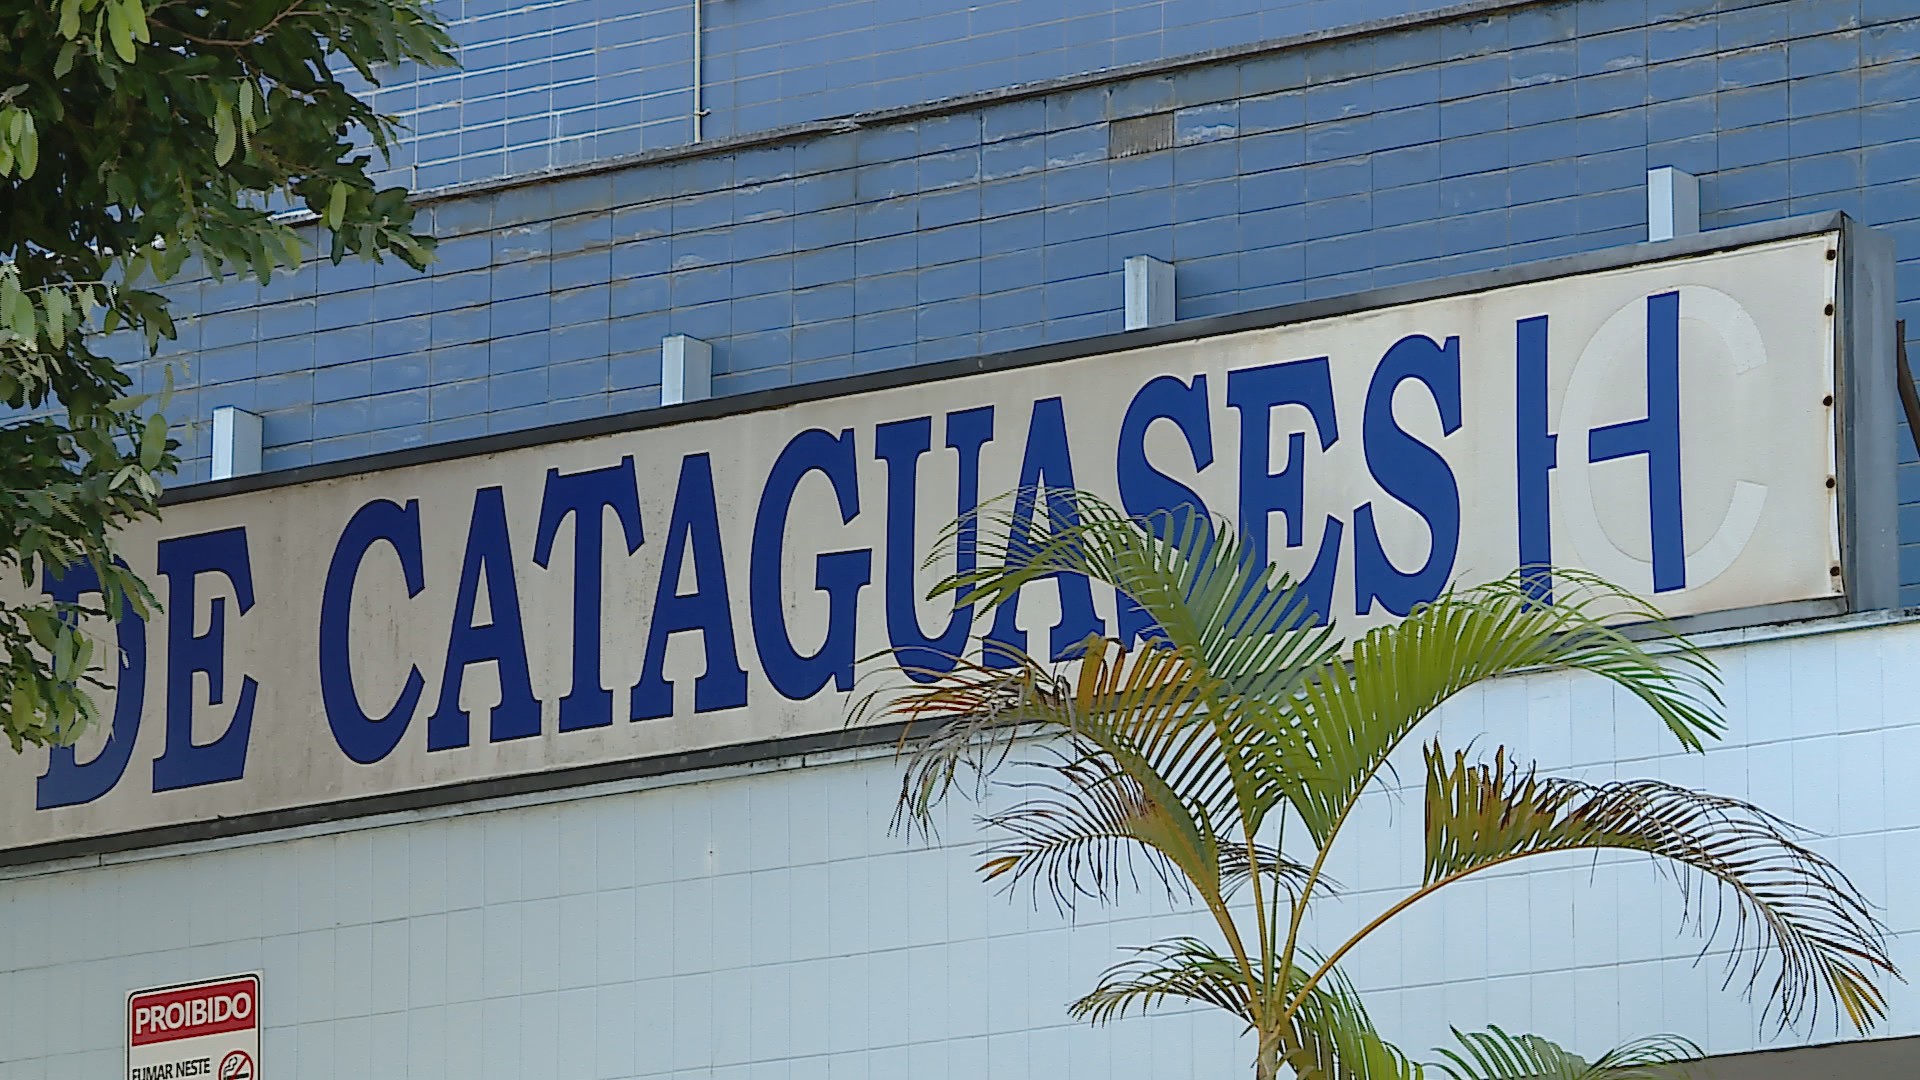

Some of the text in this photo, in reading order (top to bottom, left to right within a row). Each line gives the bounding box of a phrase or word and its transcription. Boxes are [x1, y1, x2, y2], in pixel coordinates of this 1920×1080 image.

[36, 333, 1463, 810] DE CATAGUASES
[135, 992, 252, 1034] PROIBIDO
[132, 1058, 210, 1080] FUMAR NESTE
